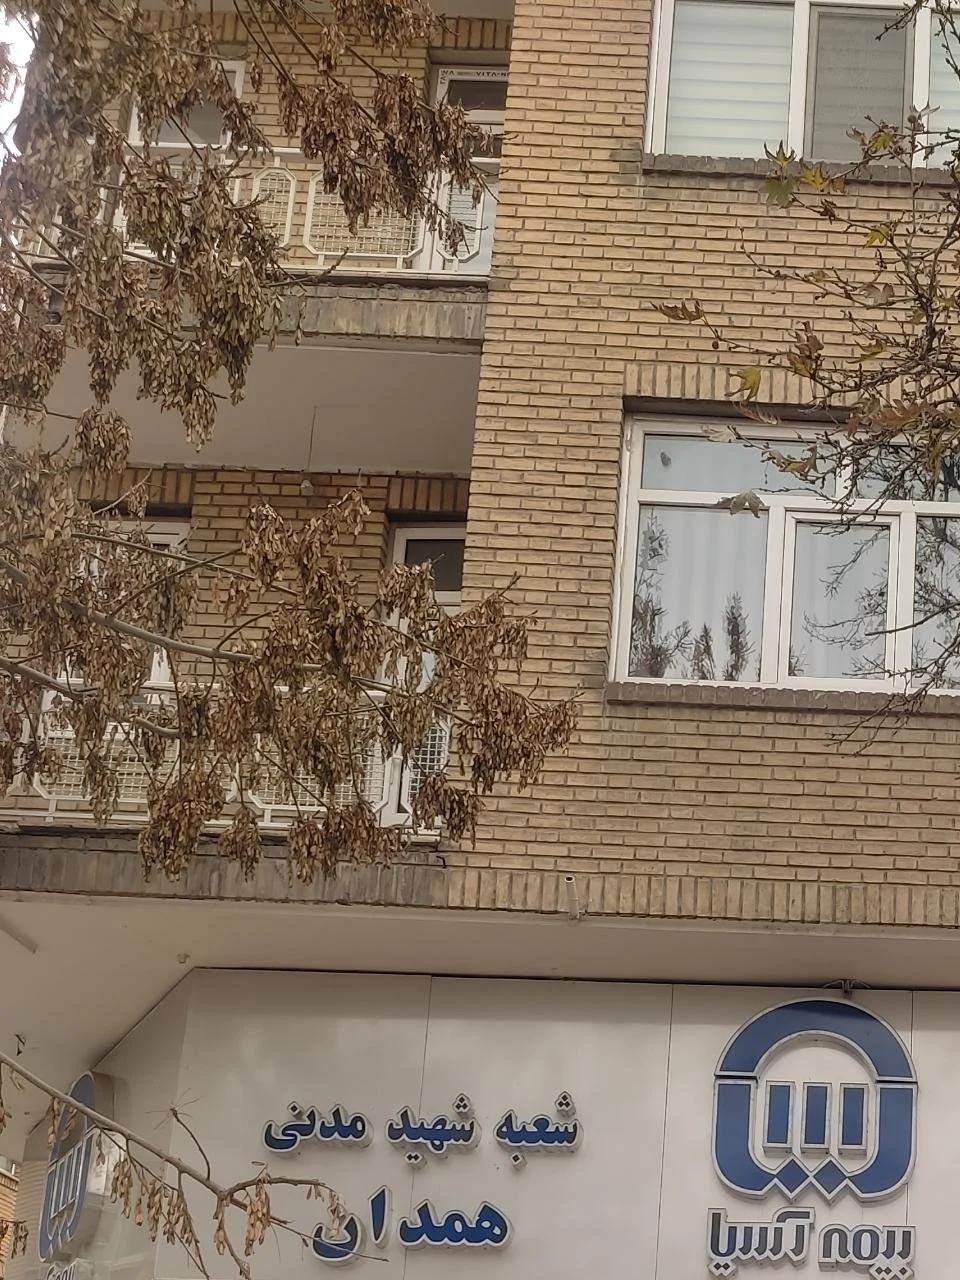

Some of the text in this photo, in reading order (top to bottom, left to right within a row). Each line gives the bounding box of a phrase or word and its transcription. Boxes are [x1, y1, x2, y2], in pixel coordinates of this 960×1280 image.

[262, 1091, 582, 1171] شعبه شهید مدنی
[311, 1186, 515, 1265] همدان
[707, 1206, 816, 1280] آسیا
